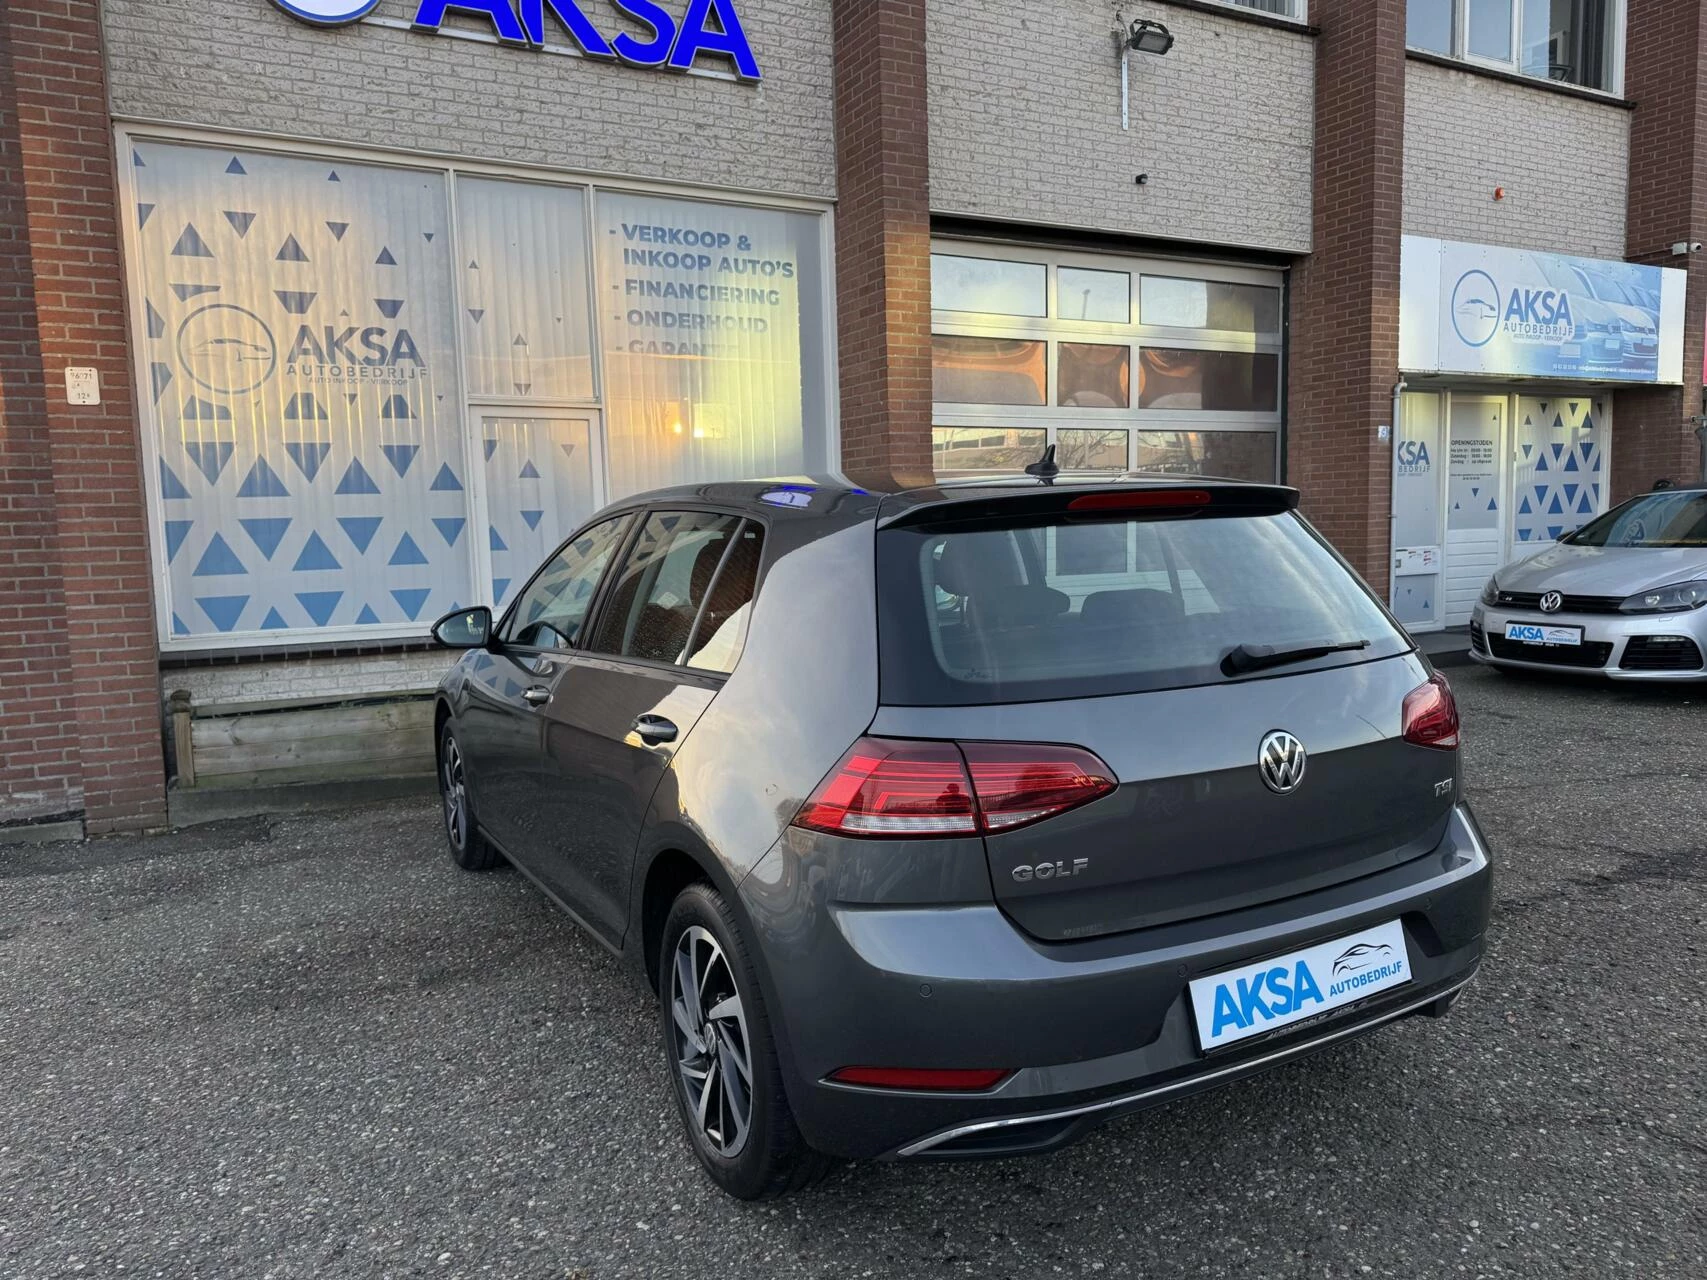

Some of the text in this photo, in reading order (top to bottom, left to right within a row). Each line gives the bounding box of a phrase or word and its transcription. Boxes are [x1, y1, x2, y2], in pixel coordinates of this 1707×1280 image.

[621, 223, 731, 249] VERKOOP
[737, 235, 751, 250] &
[623, 248, 794, 278] INKOOP AUTO'S
[625, 279, 780, 306] FINANCIERING
[1504, 288, 1573, 326] AKSA
[627, 309, 768, 333] ONDERHOUD
[1503, 322, 1573, 337] AUTOBEDRIJF
[286, 324, 426, 367] AKSA
[629, 339, 739, 356] GARANT
[286, 364, 429, 379] AUTOBEDRIJF
[1509, 626, 1544, 640] AKSA
[1434, 778, 1452, 797] TSI
[1012, 858, 1088, 881] GOLF
[1329, 961, 1402, 997] AUTOBEDRIJF
[1211, 960, 1325, 1038] AKSA
